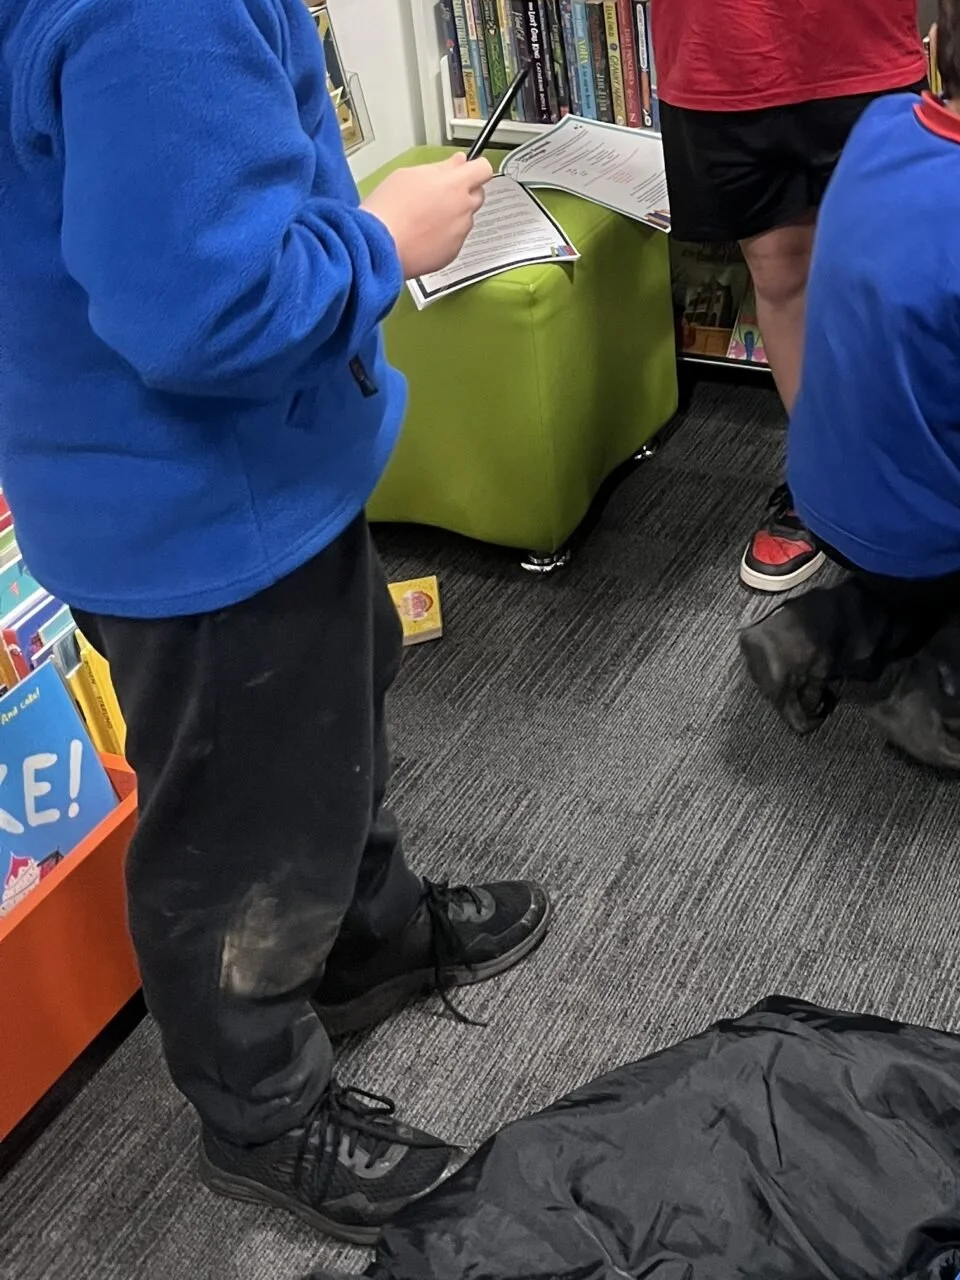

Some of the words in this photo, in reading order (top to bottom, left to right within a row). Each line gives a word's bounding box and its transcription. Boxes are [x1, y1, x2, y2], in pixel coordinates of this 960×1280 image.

[528, 11, 538, 26] LOST
[531, 43, 540, 59] KING
[536, 62, 544, 92] CATHERINE
[610, 55, 619, 84] GRANNY
[596, 73, 606, 89] JANE
[20, 686, 40, 710] cake!
